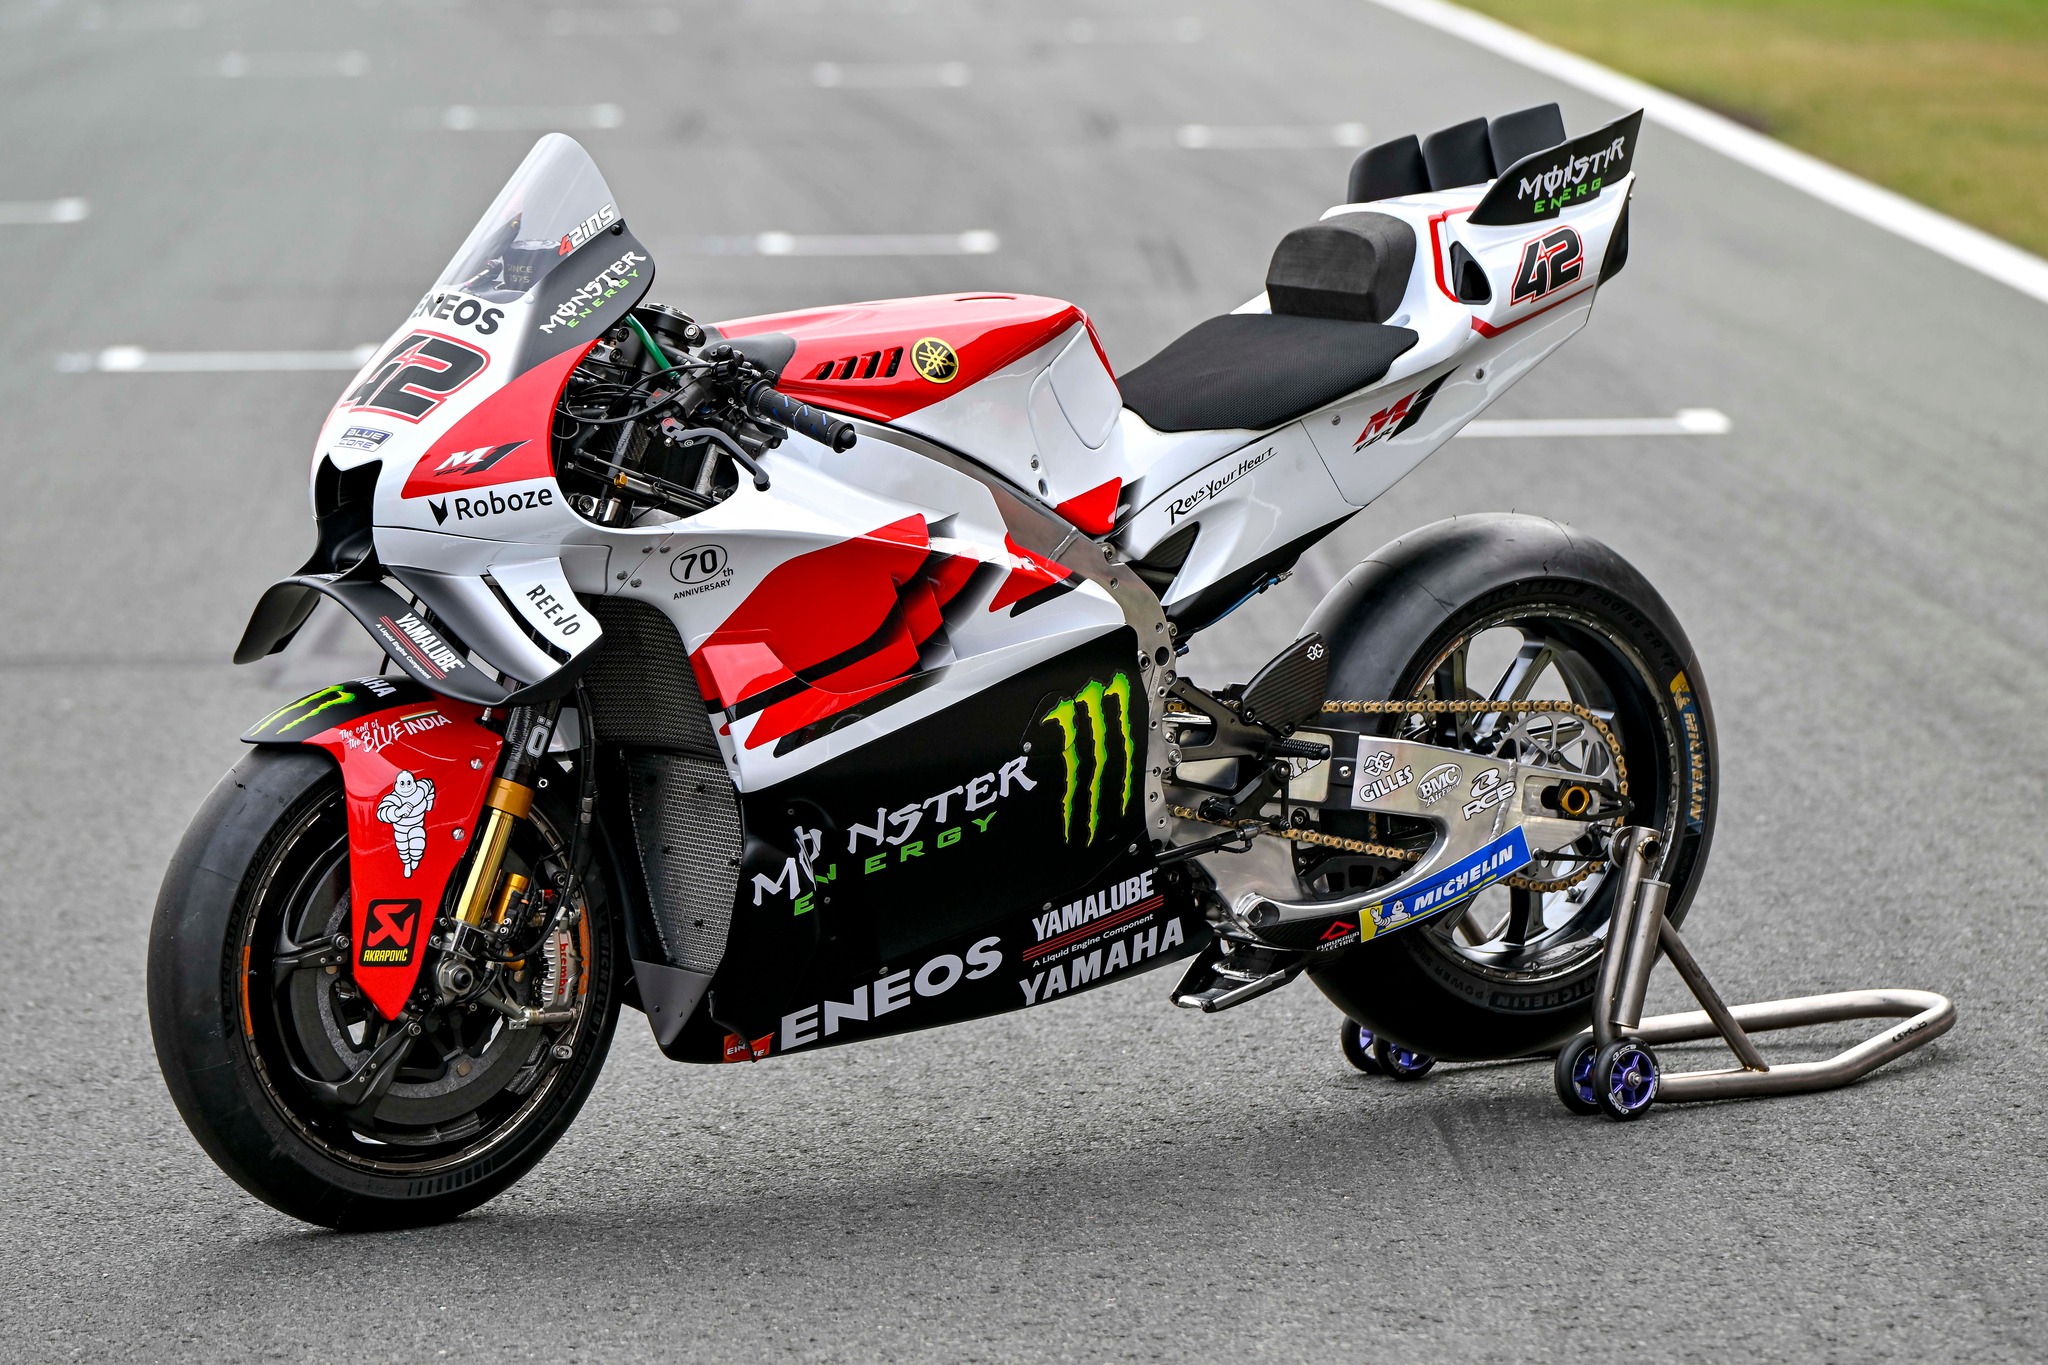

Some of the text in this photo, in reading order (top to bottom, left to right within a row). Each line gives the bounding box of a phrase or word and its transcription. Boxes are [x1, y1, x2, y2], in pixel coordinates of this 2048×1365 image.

[1534, 175, 1603, 213] ENERG
[557, 203, 615, 256] 42ins
[1510, 225, 1584, 306] 42
[540, 251, 647, 334] MONSTER
[567, 269, 639, 328] ENERGY
[342, 329, 491, 424] 42
[339, 438, 375, 449] CORE
[346, 428, 386, 441] BLUE
[455, 488, 553, 520] Roboze
[1164, 447, 1274, 525] Revs Your Heart
[673, 579, 731, 600] ANNIVERSARY
[680, 549, 734, 580] 70 th
[406, 655, 433, 680] Component
[339, 719, 380, 741] The call of
[346, 714, 453, 753] the BLUE INDIA
[1359, 765, 1414, 802] GILLES
[1419, 767, 1458, 799] BMC
[1462, 781, 1517, 821] RCB
[751, 756, 1038, 906] MONSTER
[793, 811, 998, 917] ENERGY
[1413, 845, 1514, 911] MICHELIN
[1019, 917, 1184, 1006] YAMAHA
[1032, 913, 1154, 968] A Liquid Engine Component
[560, 943, 569, 995] brembo
[781, 936, 1003, 1050] ENEOS
